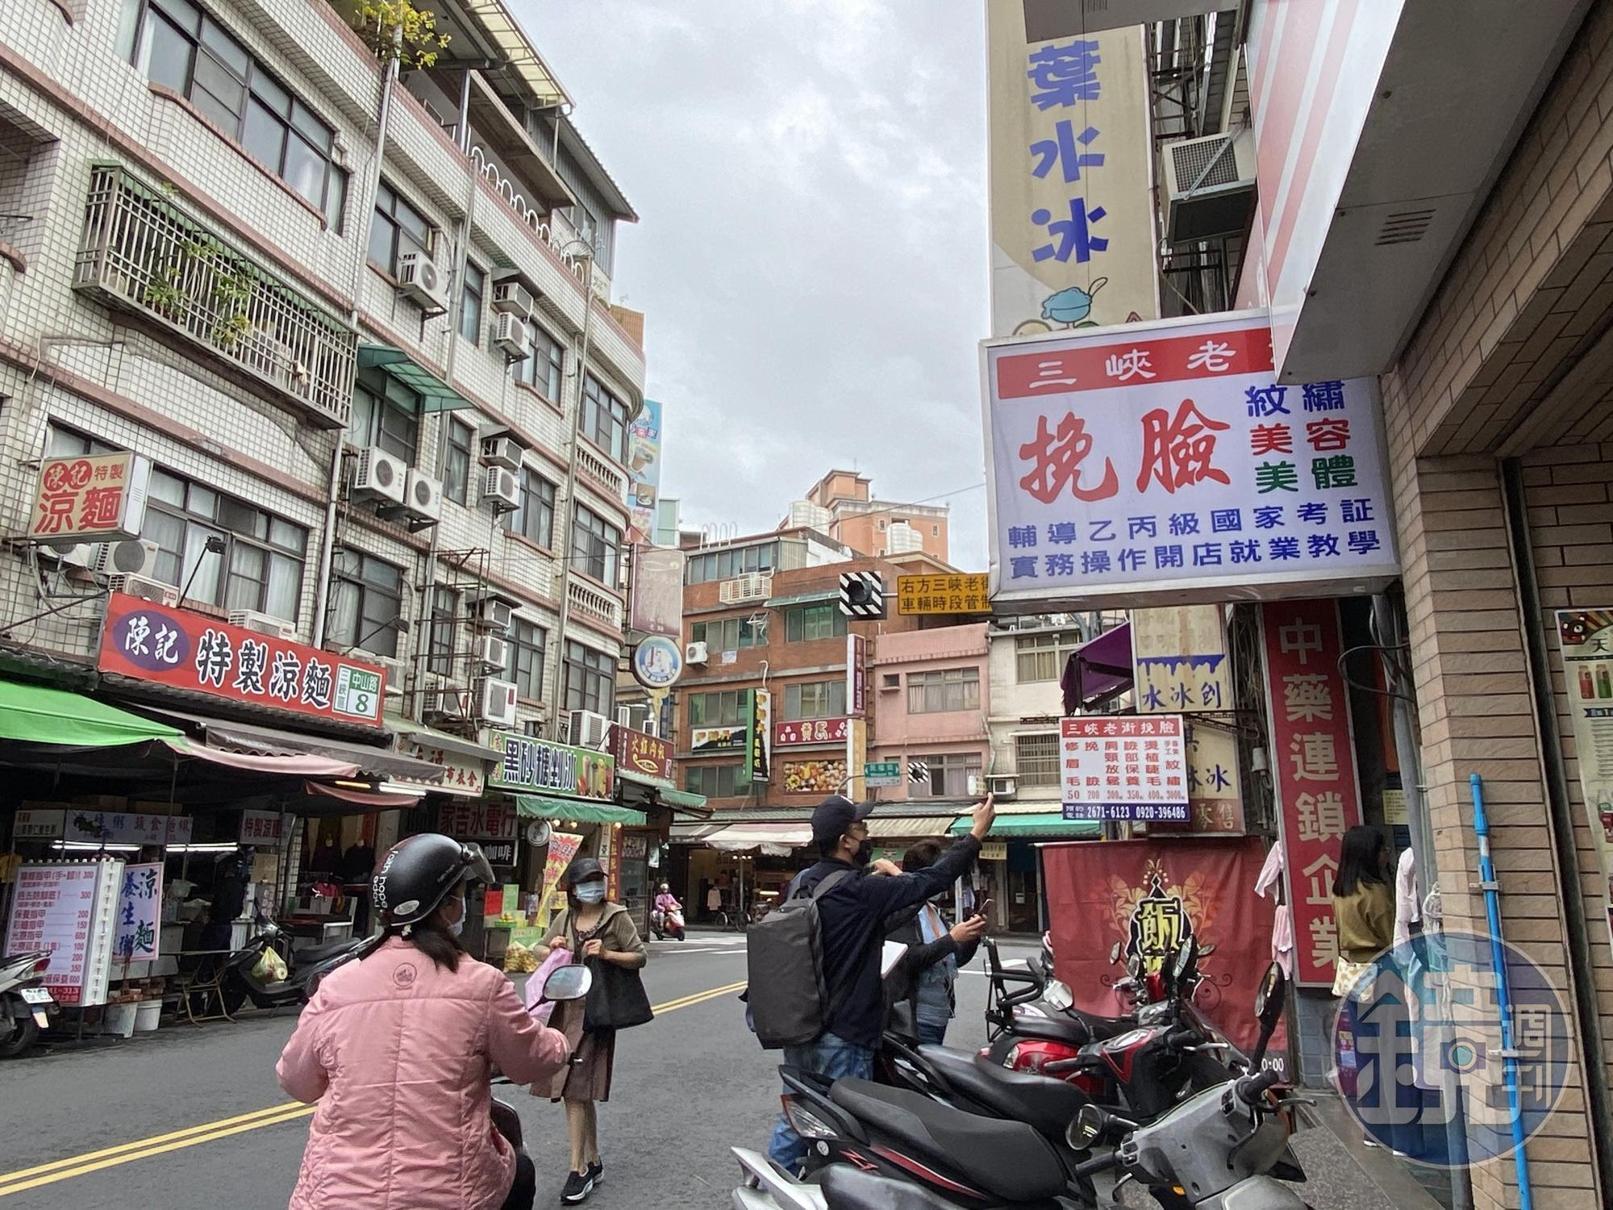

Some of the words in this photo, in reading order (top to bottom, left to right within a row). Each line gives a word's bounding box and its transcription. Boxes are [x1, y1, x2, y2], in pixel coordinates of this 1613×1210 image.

[1027, 39, 1109, 264] 葉水冰
[1029, 340, 1274, 389] 三峽老
[1245, 381, 1345, 417] 紋繡
[1018, 398, 1231, 504] 挽臉
[1250, 417, 1351, 456] 美容
[1254, 459, 1358, 495] 美體
[34, 486, 123, 534] 涼麵
[1008, 498, 1375, 549] 輔導乙丙級國家考証
[1010, 530, 1381, 580] 實務操作開店就業教學
[125, 615, 179, 664] 陳記
[196, 628, 332, 709] 特製涼麵
[352, 672, 378, 692] 中山路
[355, 693, 369, 713] 8
[1067, 790, 1080, 800] 50
[1087, 806, 1130, 818] 2671-6123
[1135, 806, 1186, 819] 0920-396486
[1278, 616, 1346, 979] 中藥連鎖企業
[135, 868, 158, 953] 涼麵
